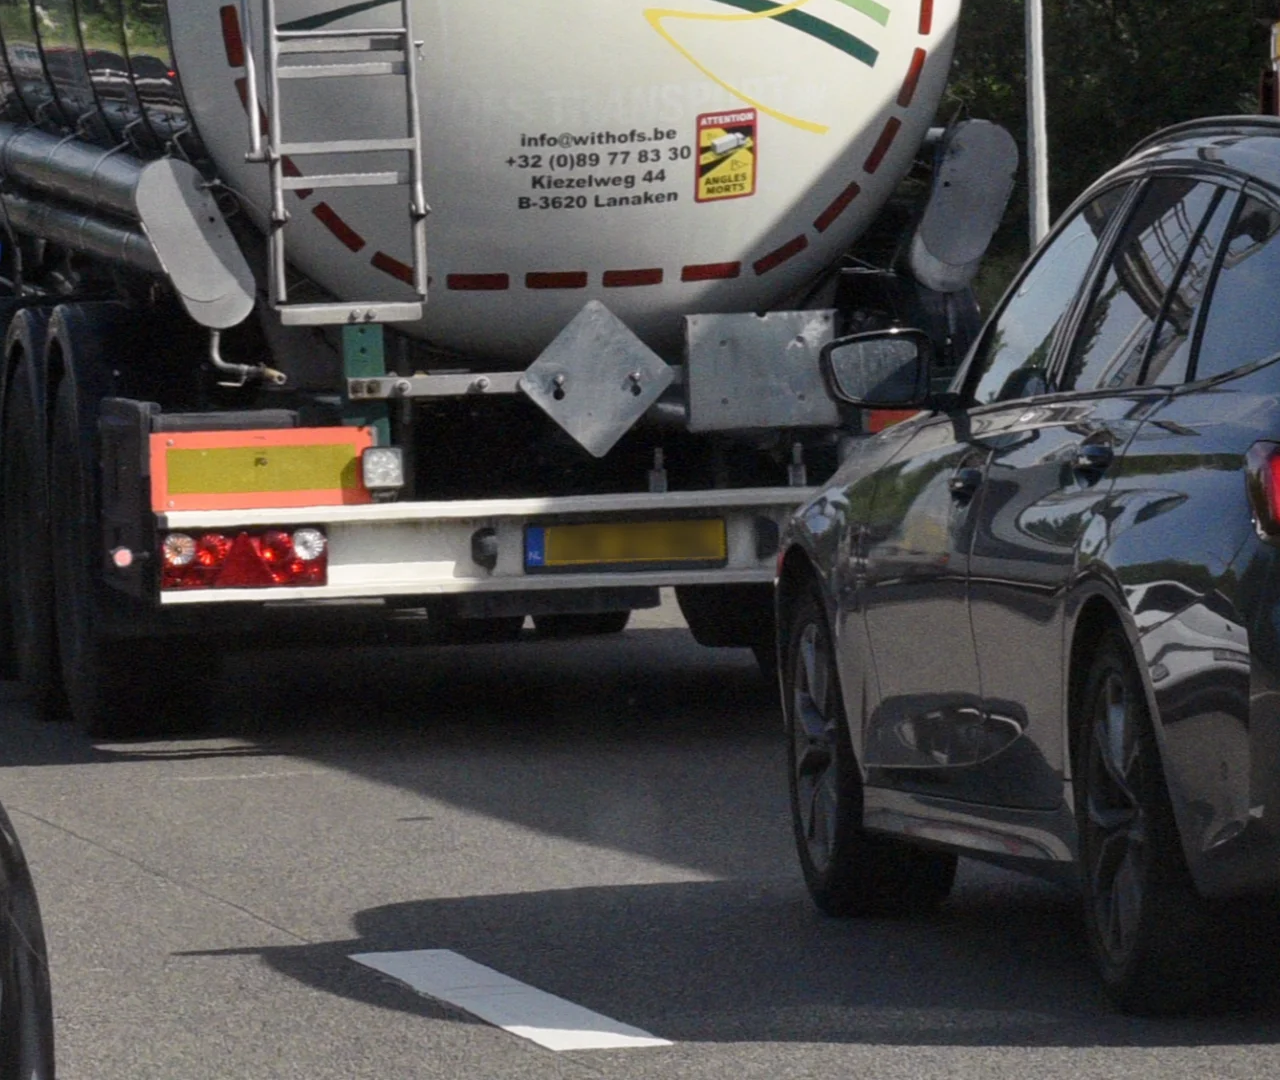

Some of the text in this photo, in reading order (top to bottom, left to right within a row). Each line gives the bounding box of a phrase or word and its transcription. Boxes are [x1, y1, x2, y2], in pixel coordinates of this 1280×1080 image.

[700, 111, 755, 126] ATTENTION
[520, 127, 677, 149] info@withofs.be
[504, 145, 692, 171] +32 (0)89 77 83 30
[531, 169, 667, 190] Kiezelweg 44
[704, 171, 748, 187] ANGLES
[706, 182, 746, 195] MORTS
[517, 190, 679, 211] B-3620 Lanaken
